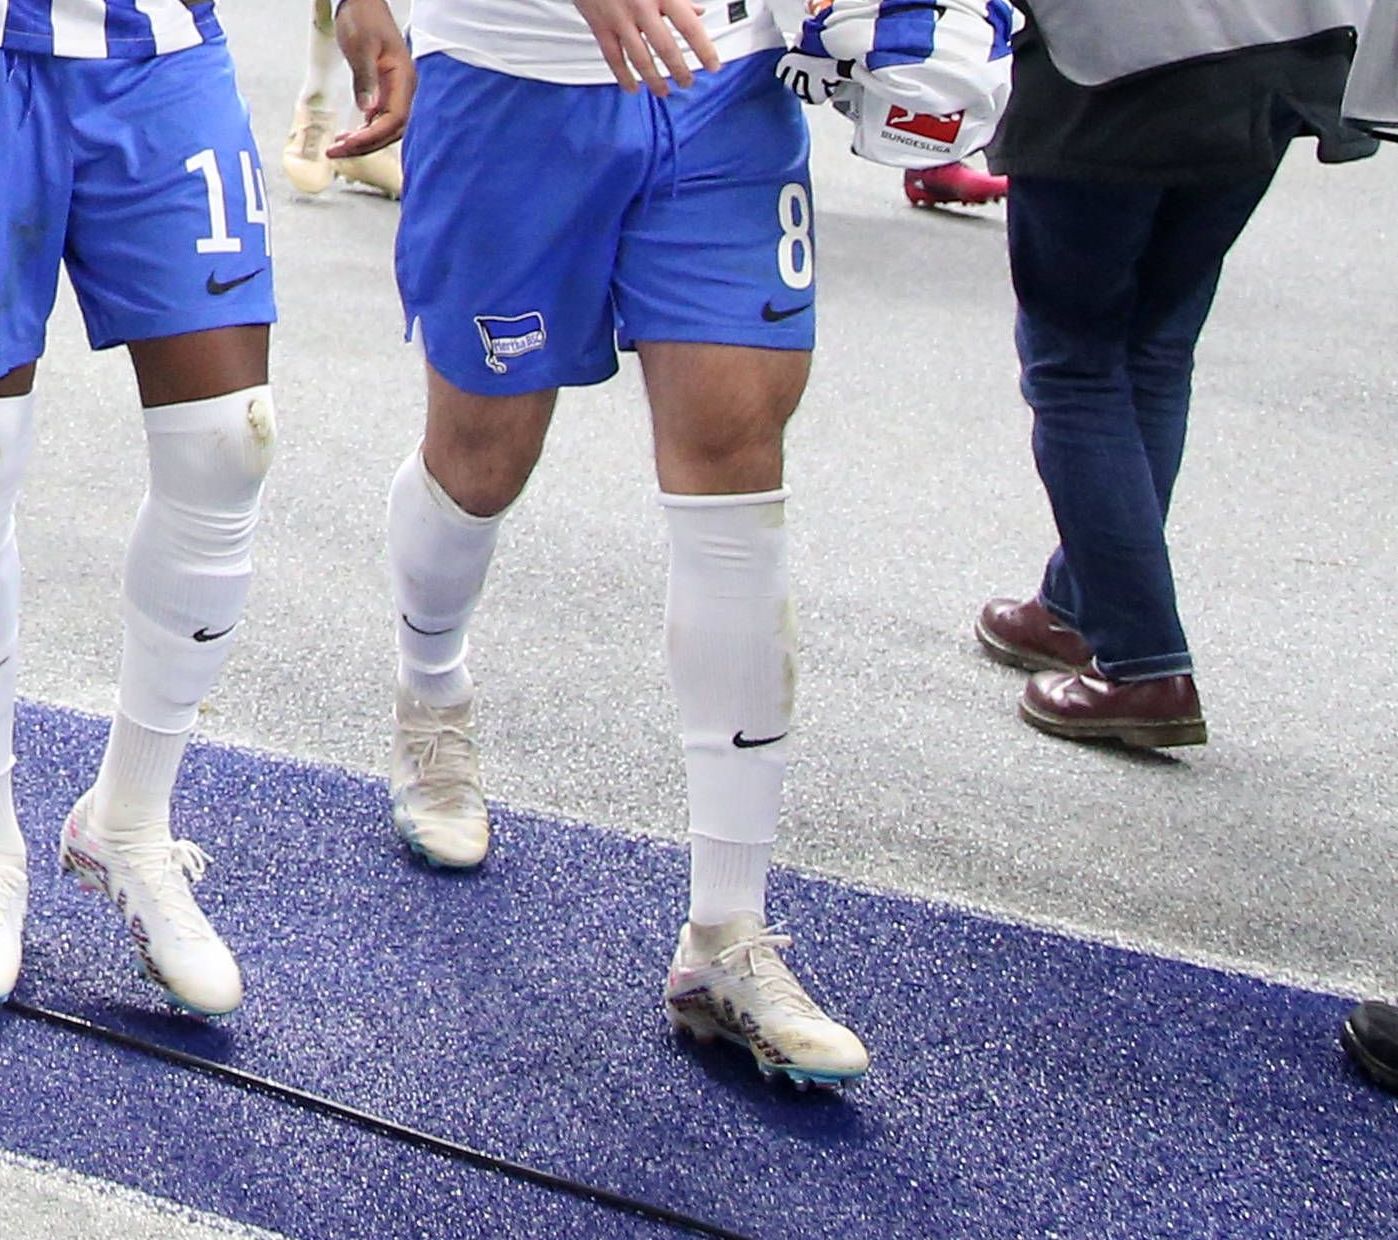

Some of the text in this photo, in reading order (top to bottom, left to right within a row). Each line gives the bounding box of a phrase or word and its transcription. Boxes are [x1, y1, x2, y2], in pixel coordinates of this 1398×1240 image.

[880, 129, 952, 155] BUNDESLIGA
[185, 148, 271, 257] 14
[776, 182, 813, 290] 8
